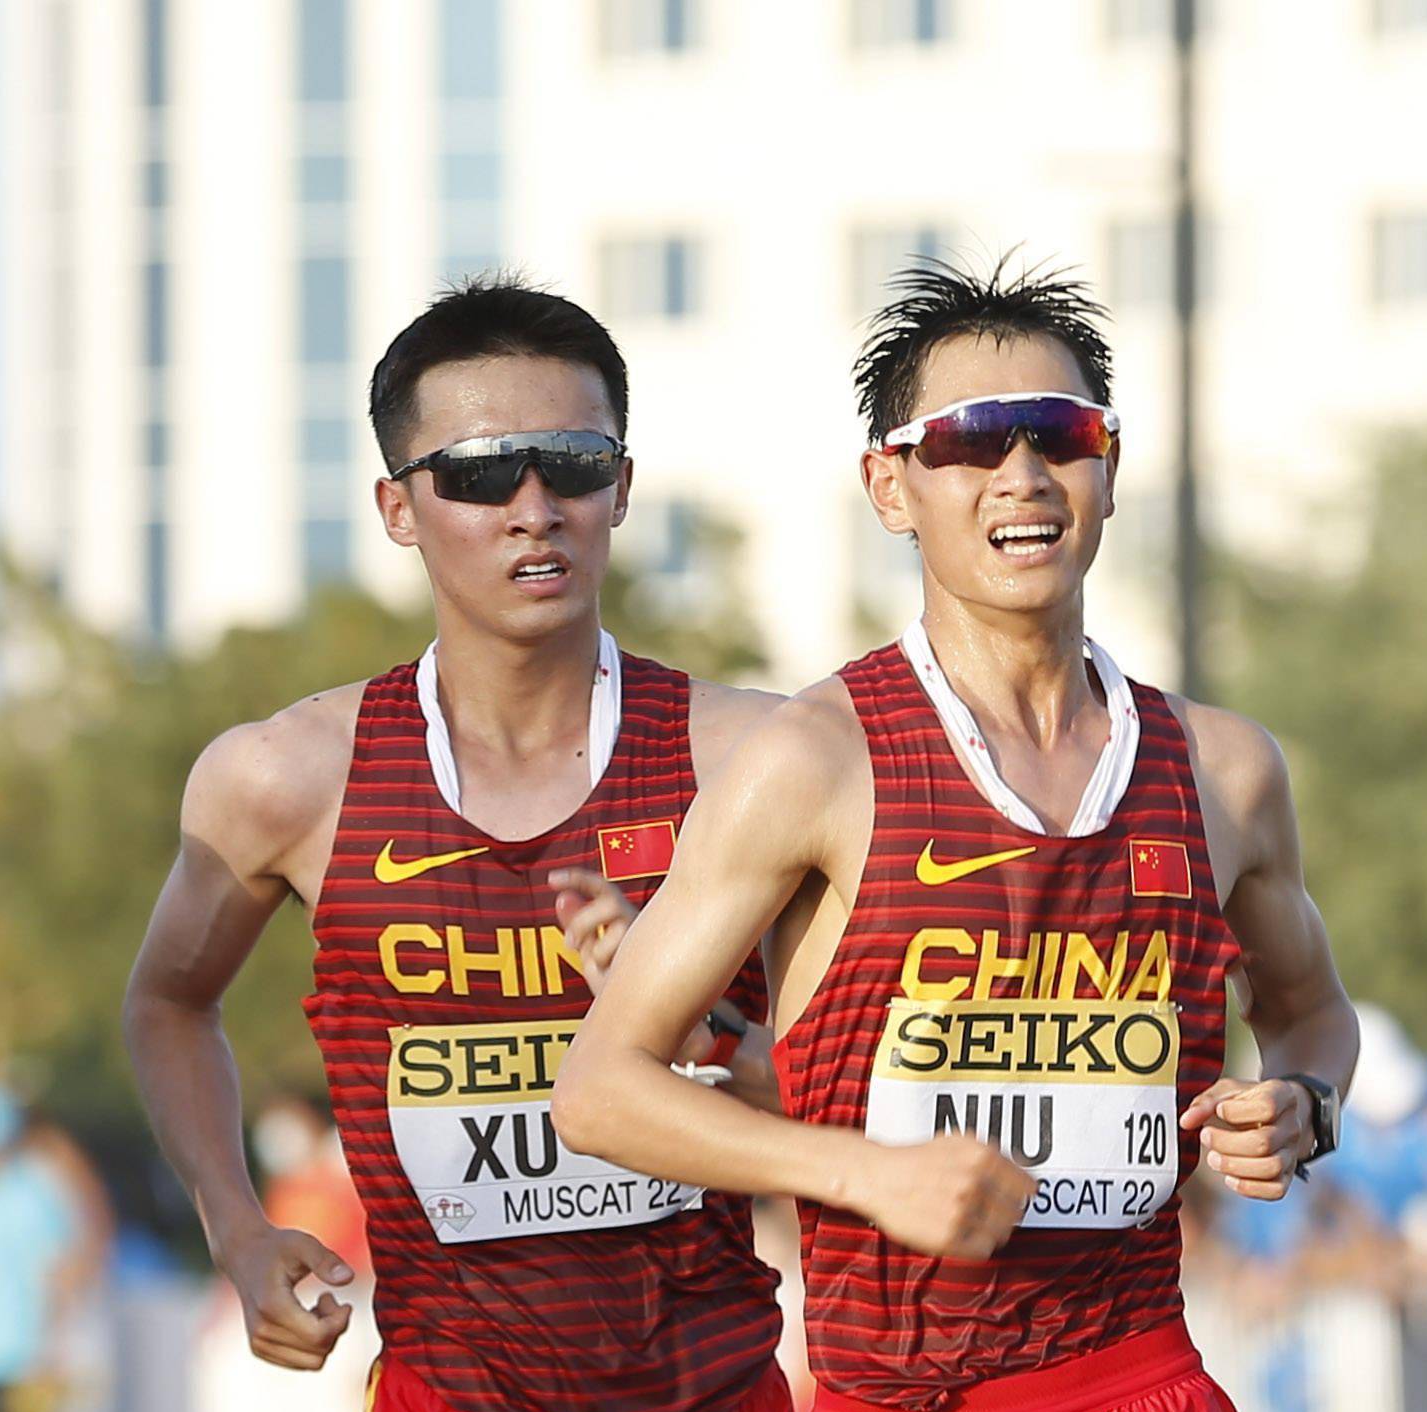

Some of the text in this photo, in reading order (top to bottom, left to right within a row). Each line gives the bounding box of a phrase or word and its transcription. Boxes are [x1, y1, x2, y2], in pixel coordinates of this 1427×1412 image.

[378, 922, 586, 998] CHIN
[900, 928, 1172, 1002] CHINA
[398, 1032, 575, 1098] SEI
[889, 1012, 1171, 1074] SEIKO
[459, 1111, 558, 1183] XU
[933, 1093, 1167, 1168] NIU 120
[503, 1177, 683, 1225] MUSCAT 22
[1022, 1178, 1156, 1216] SCAT 22
